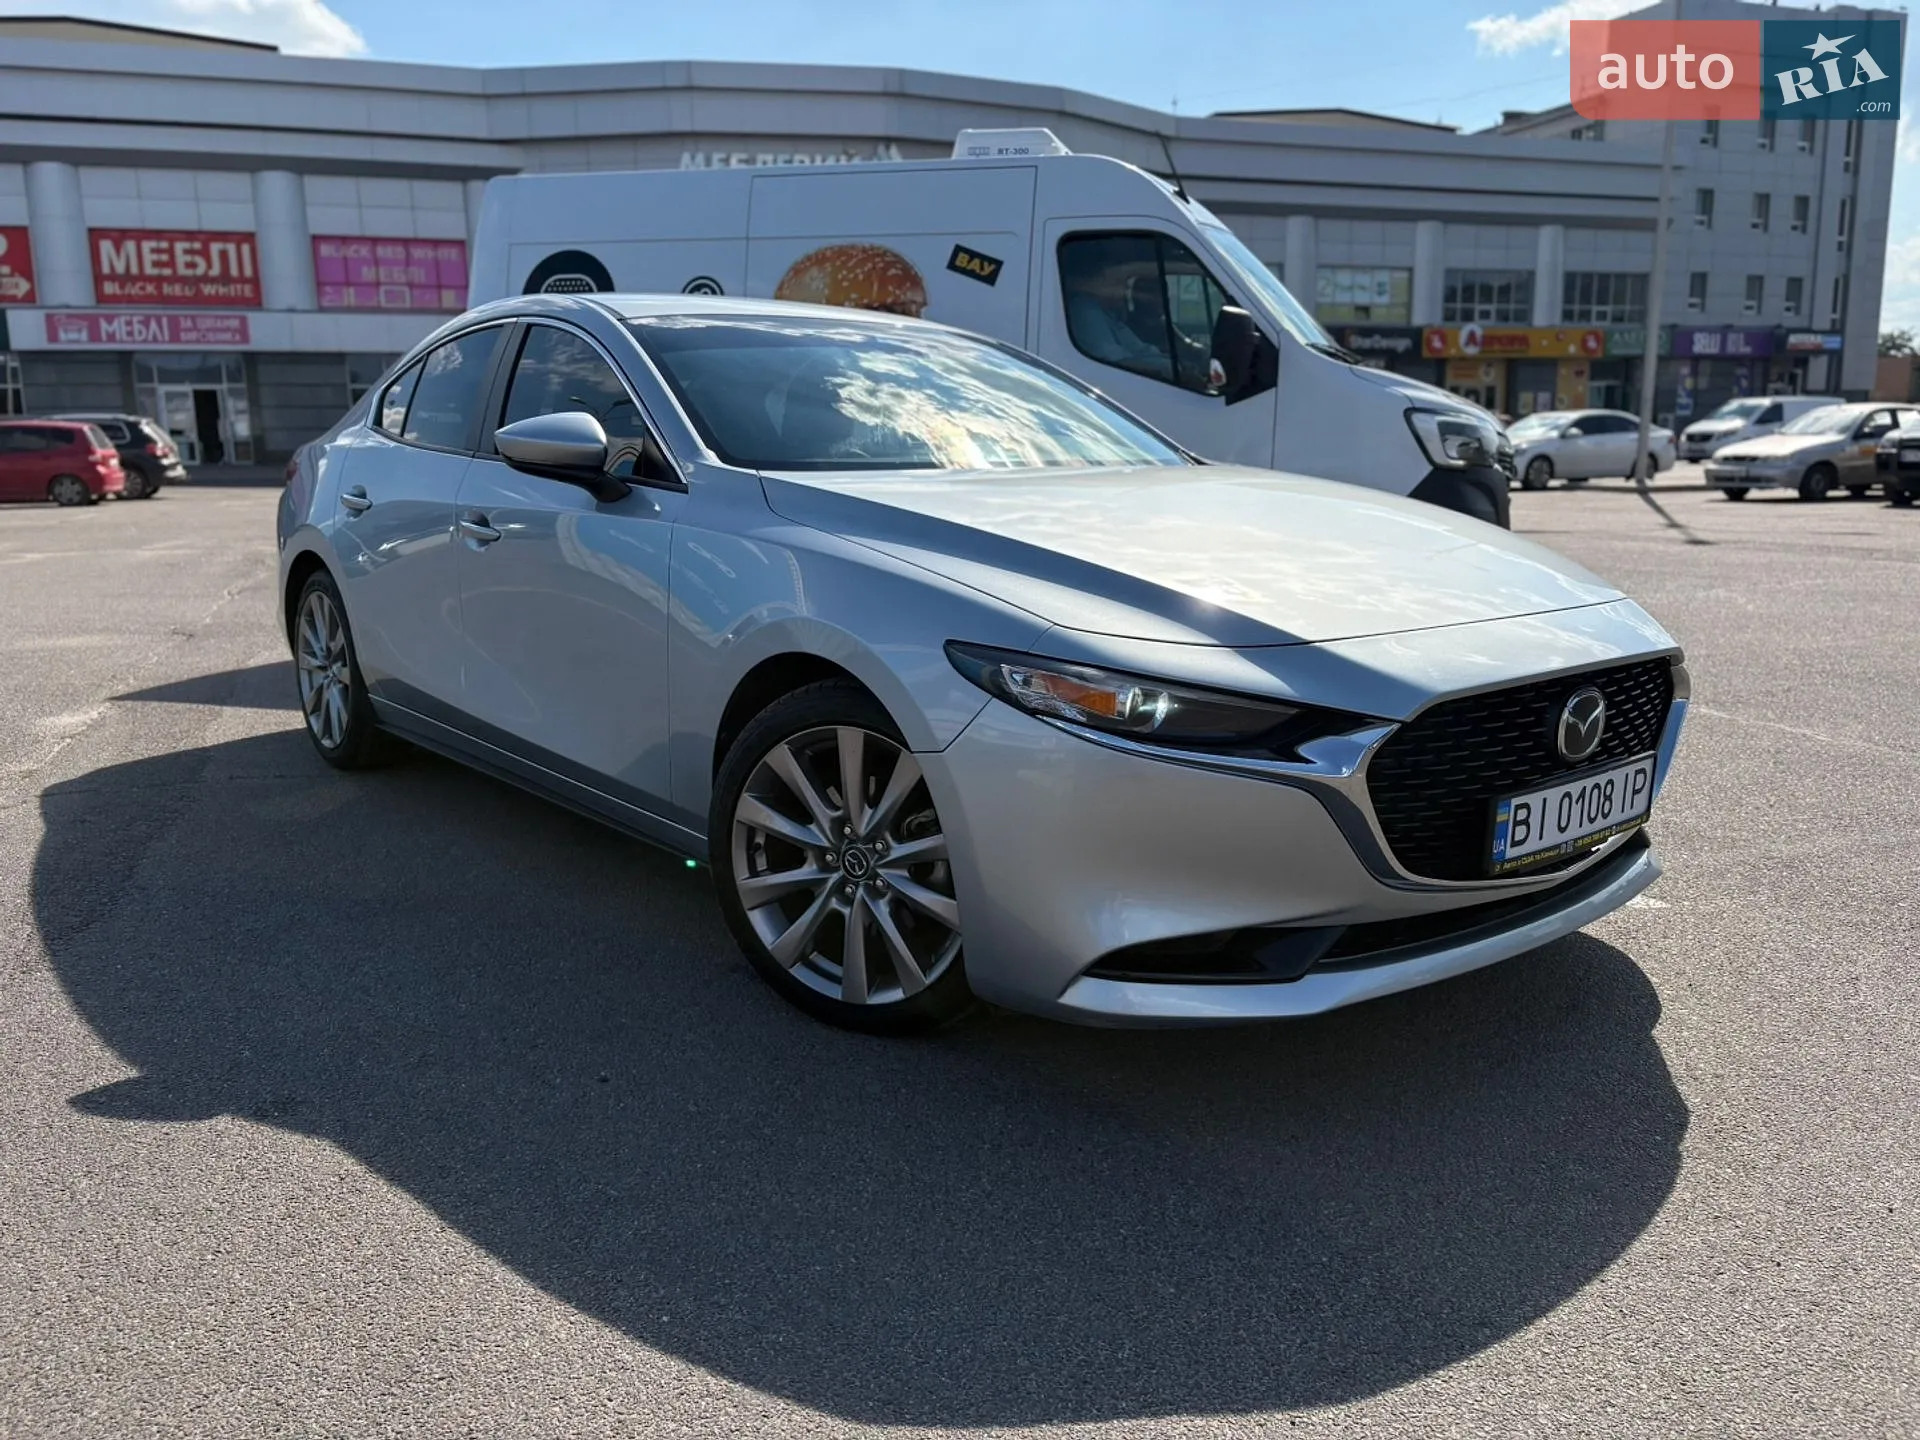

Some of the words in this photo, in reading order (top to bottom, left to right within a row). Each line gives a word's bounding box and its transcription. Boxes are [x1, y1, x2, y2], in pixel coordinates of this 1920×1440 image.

[99, 239, 254, 278] МЕБЛІ
[103, 281, 157, 296] BLACK
[162, 283, 196, 297] RED
[200, 283, 254, 298] WHITE
[99, 315, 170, 342] МЕБЛІ
[1509, 797, 1547, 848] BI
[1557, 778, 1615, 835] 0108
[1621, 767, 1648, 814] IP
[1492, 839, 1505, 853] UA
